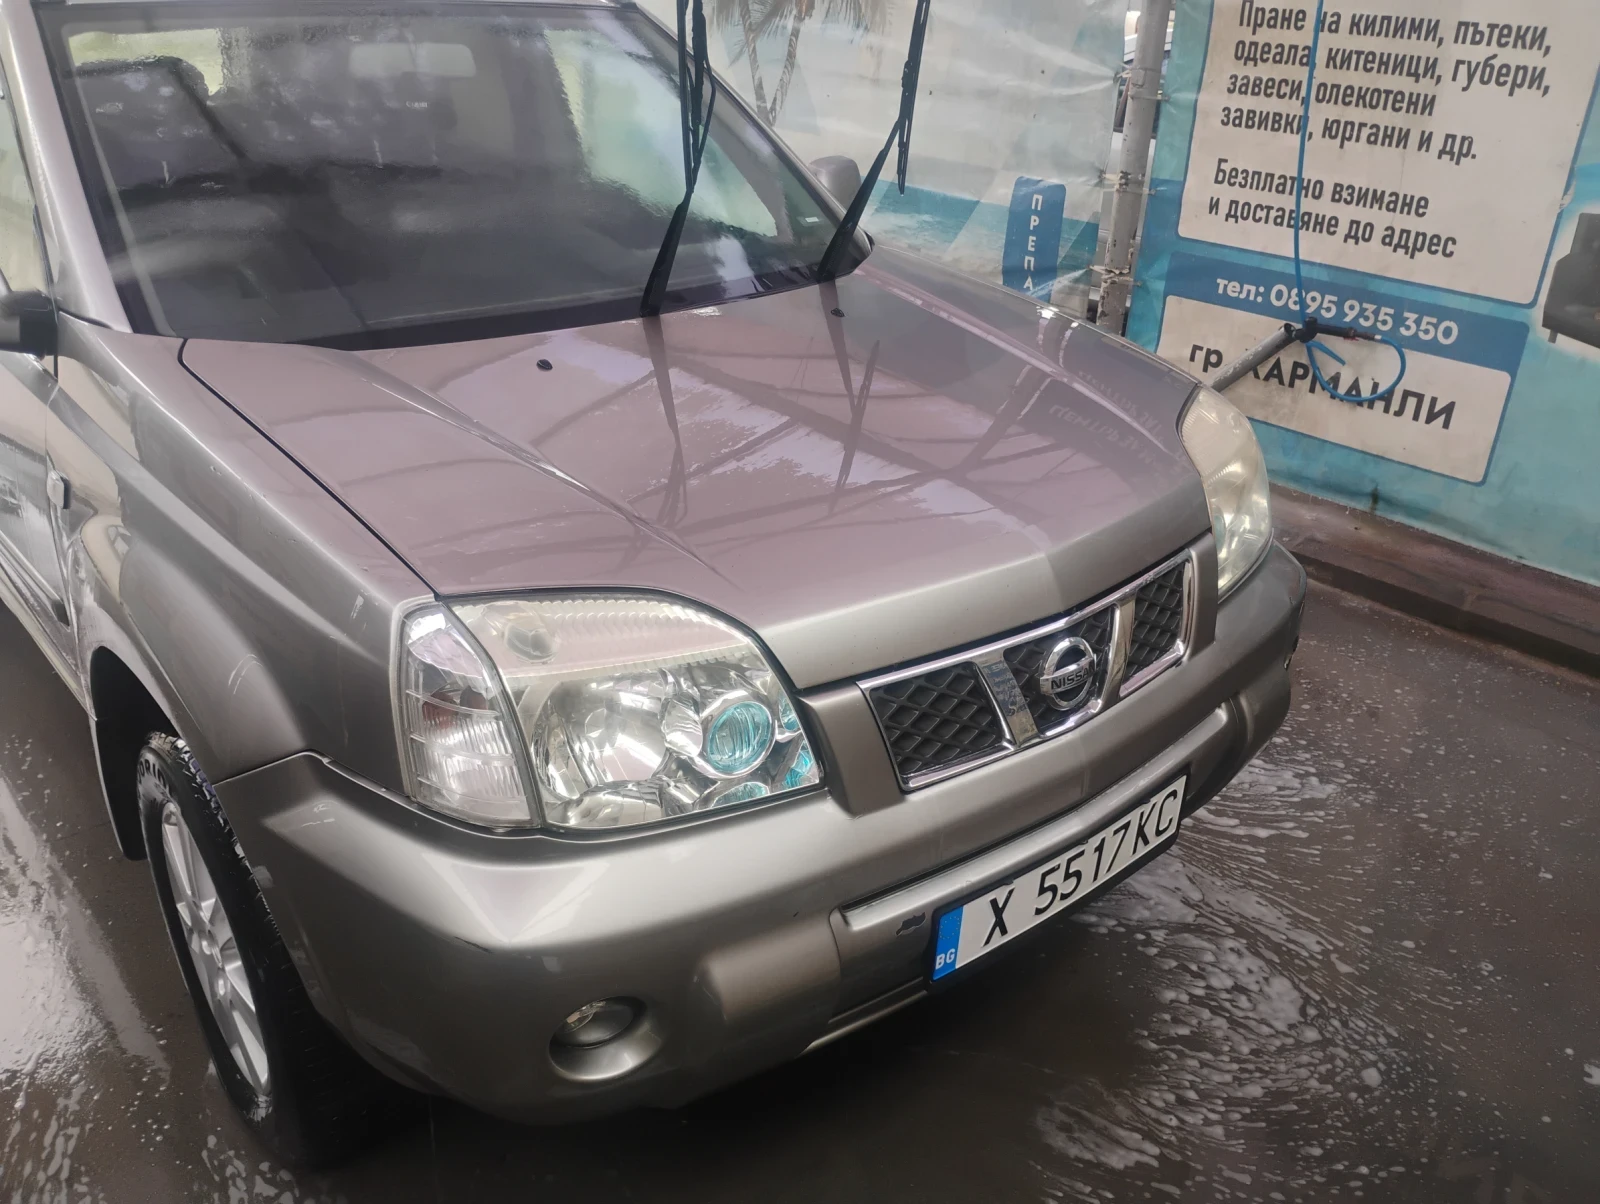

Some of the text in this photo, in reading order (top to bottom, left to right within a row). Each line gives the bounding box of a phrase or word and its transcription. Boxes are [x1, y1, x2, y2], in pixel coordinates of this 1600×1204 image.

[1239, 0, 1306, 35] Пране
[1349, 13, 1444, 49] килими,
[1453, 20, 1551, 58] пътеки,
[1234, 40, 1550, 97] одеала китеници, губери,
[1315, 81, 1436, 116] олекотени
[1321, 117, 1411, 150] юргани
[1417, 130, 1433, 152] и
[1437, 133, 1476, 166] др.
[1214, 158, 1429, 217] Безплатно взимане
[1208, 196, 1457, 259] и доставяне до адрес
[1216, 278, 1459, 345] тел: 0895 935 350
[1251, 355, 1456, 430] АРМАНЛИ
[1050, 664, 1095, 690] NISSAN
[935, 948, 956, 970] BG
